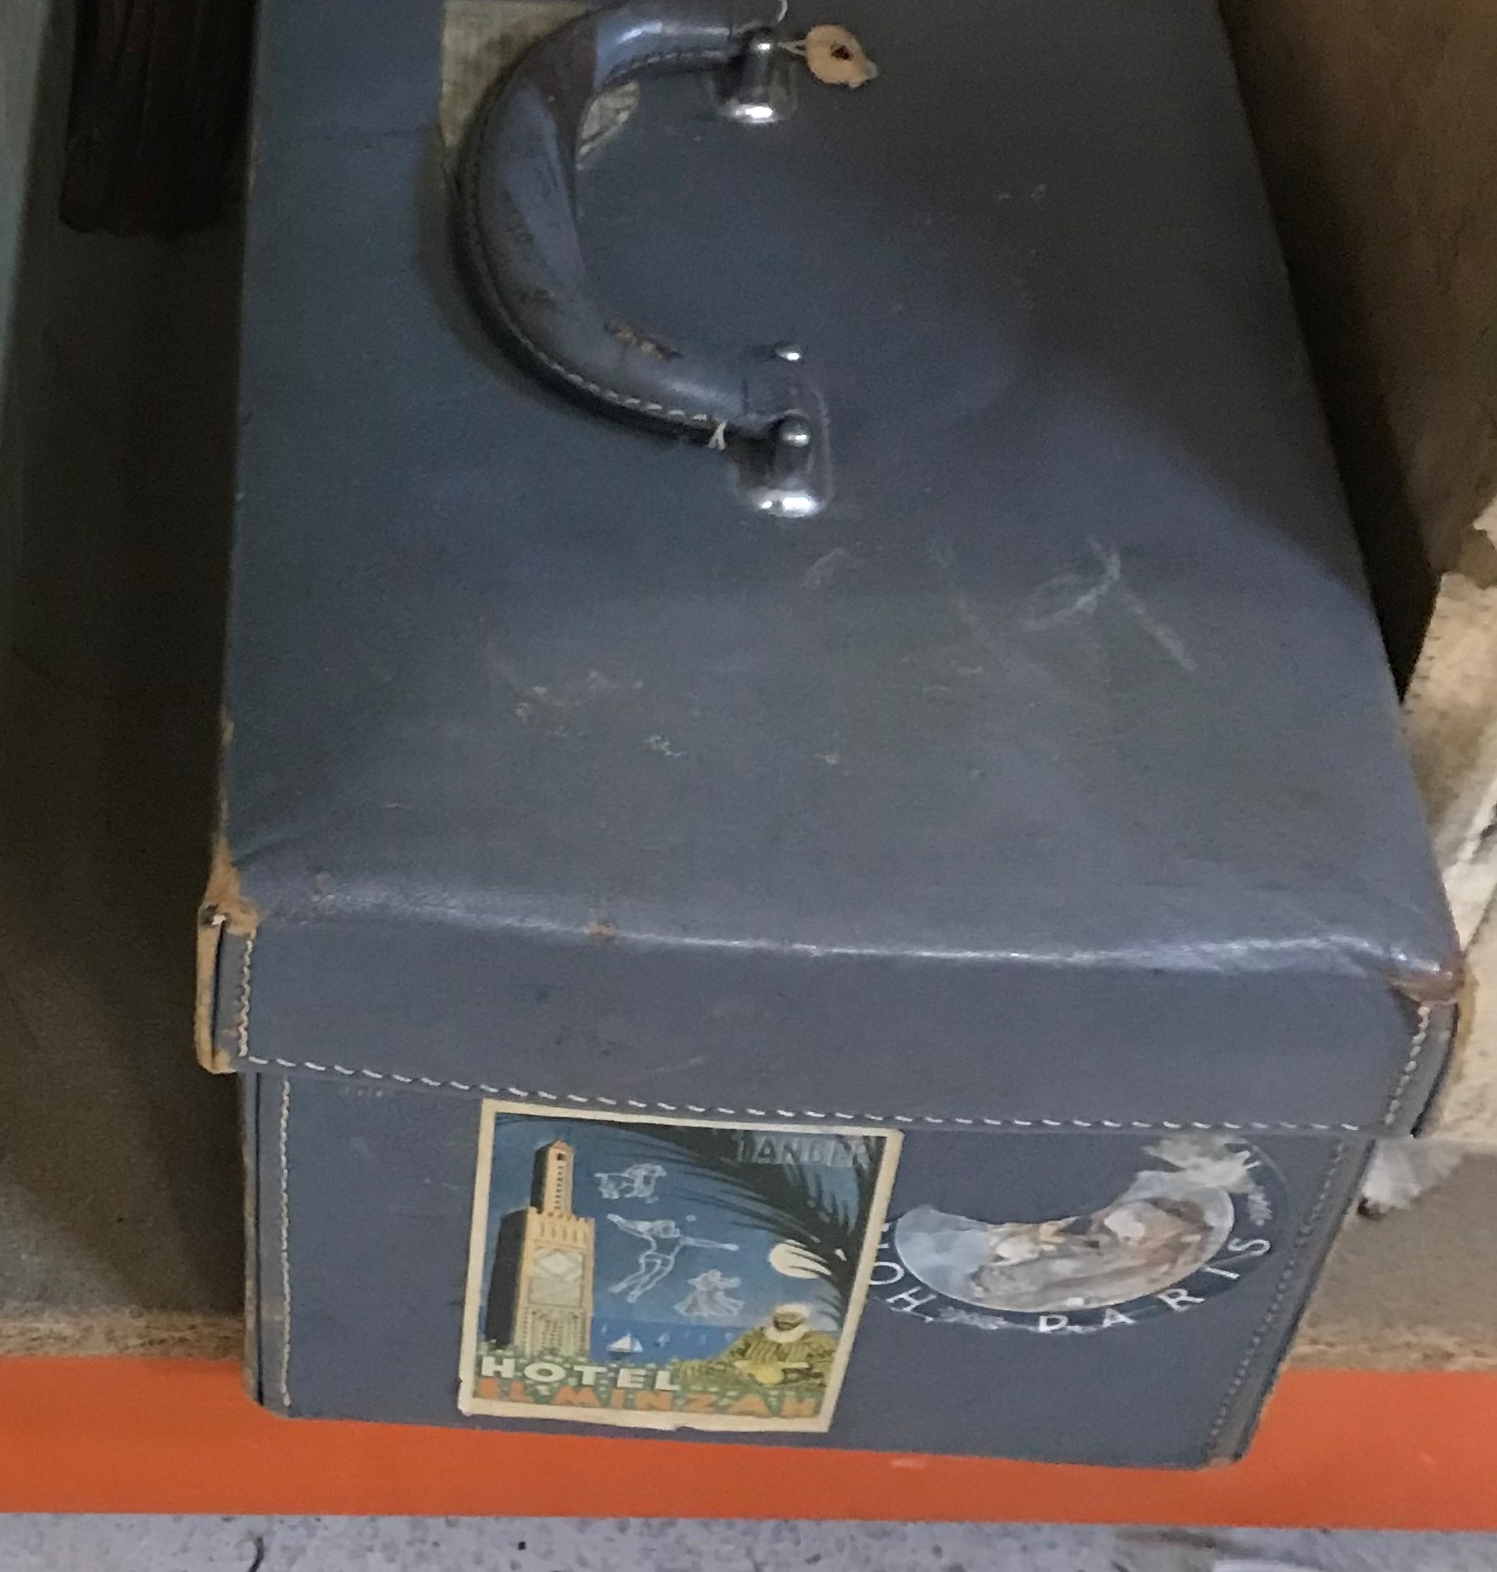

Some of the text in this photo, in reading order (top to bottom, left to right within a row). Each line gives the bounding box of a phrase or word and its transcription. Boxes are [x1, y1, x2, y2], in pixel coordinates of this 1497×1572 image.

[1038, 1237, 1272, 1332] PARIS
[480, 1355, 680, 1391] HOTEL
[478, 1377, 822, 1419] EL MINZAH
